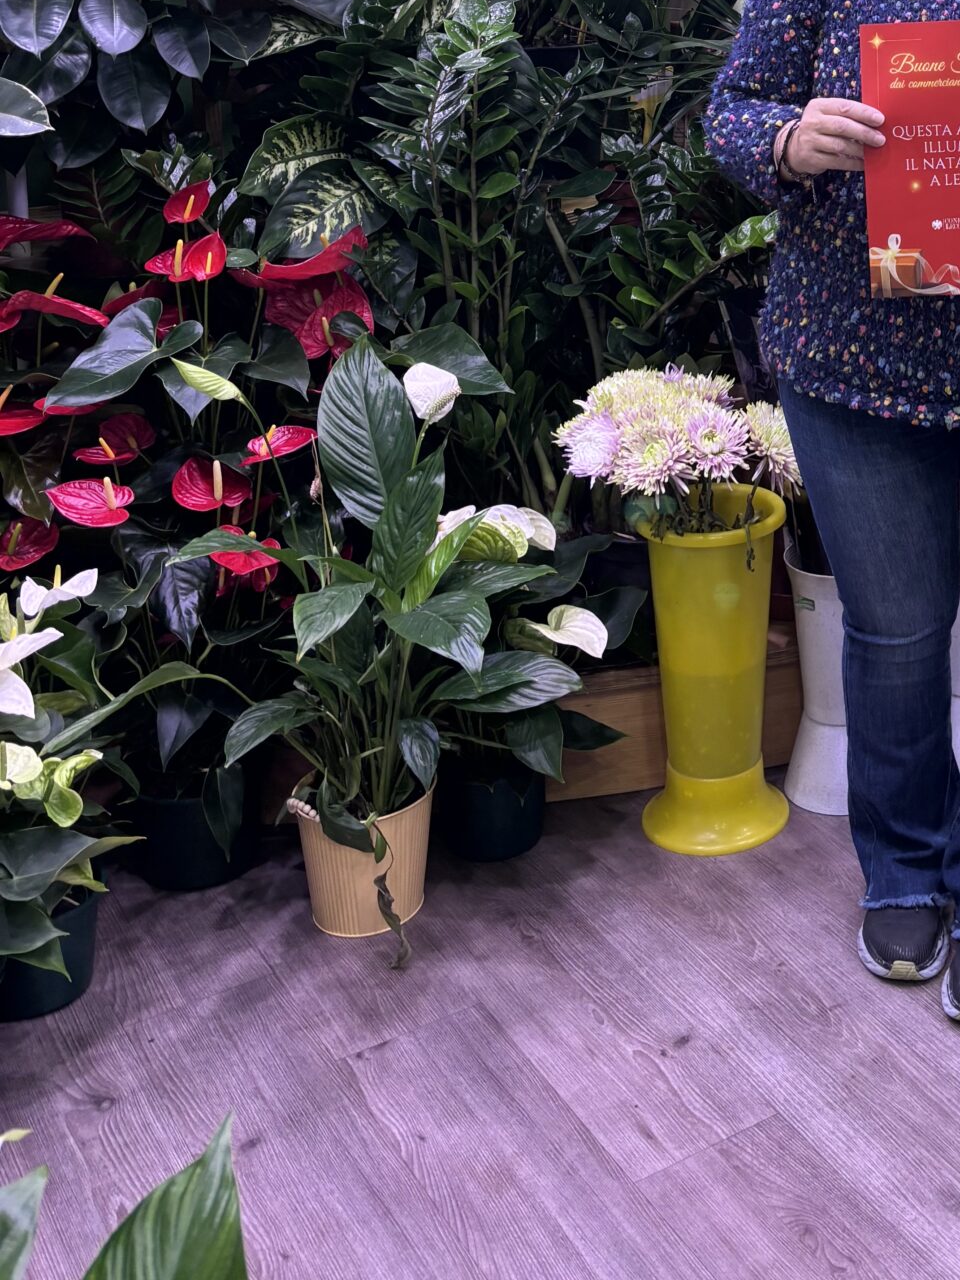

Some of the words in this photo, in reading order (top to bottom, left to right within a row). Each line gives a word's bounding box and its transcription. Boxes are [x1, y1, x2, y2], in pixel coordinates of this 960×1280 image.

[890, 53, 945, 74] Buone
[890, 77, 905, 89] dai
[892, 124, 952, 140] QUESTA
[905, 158, 919, 171] IL
[930, 174, 941, 187] A
